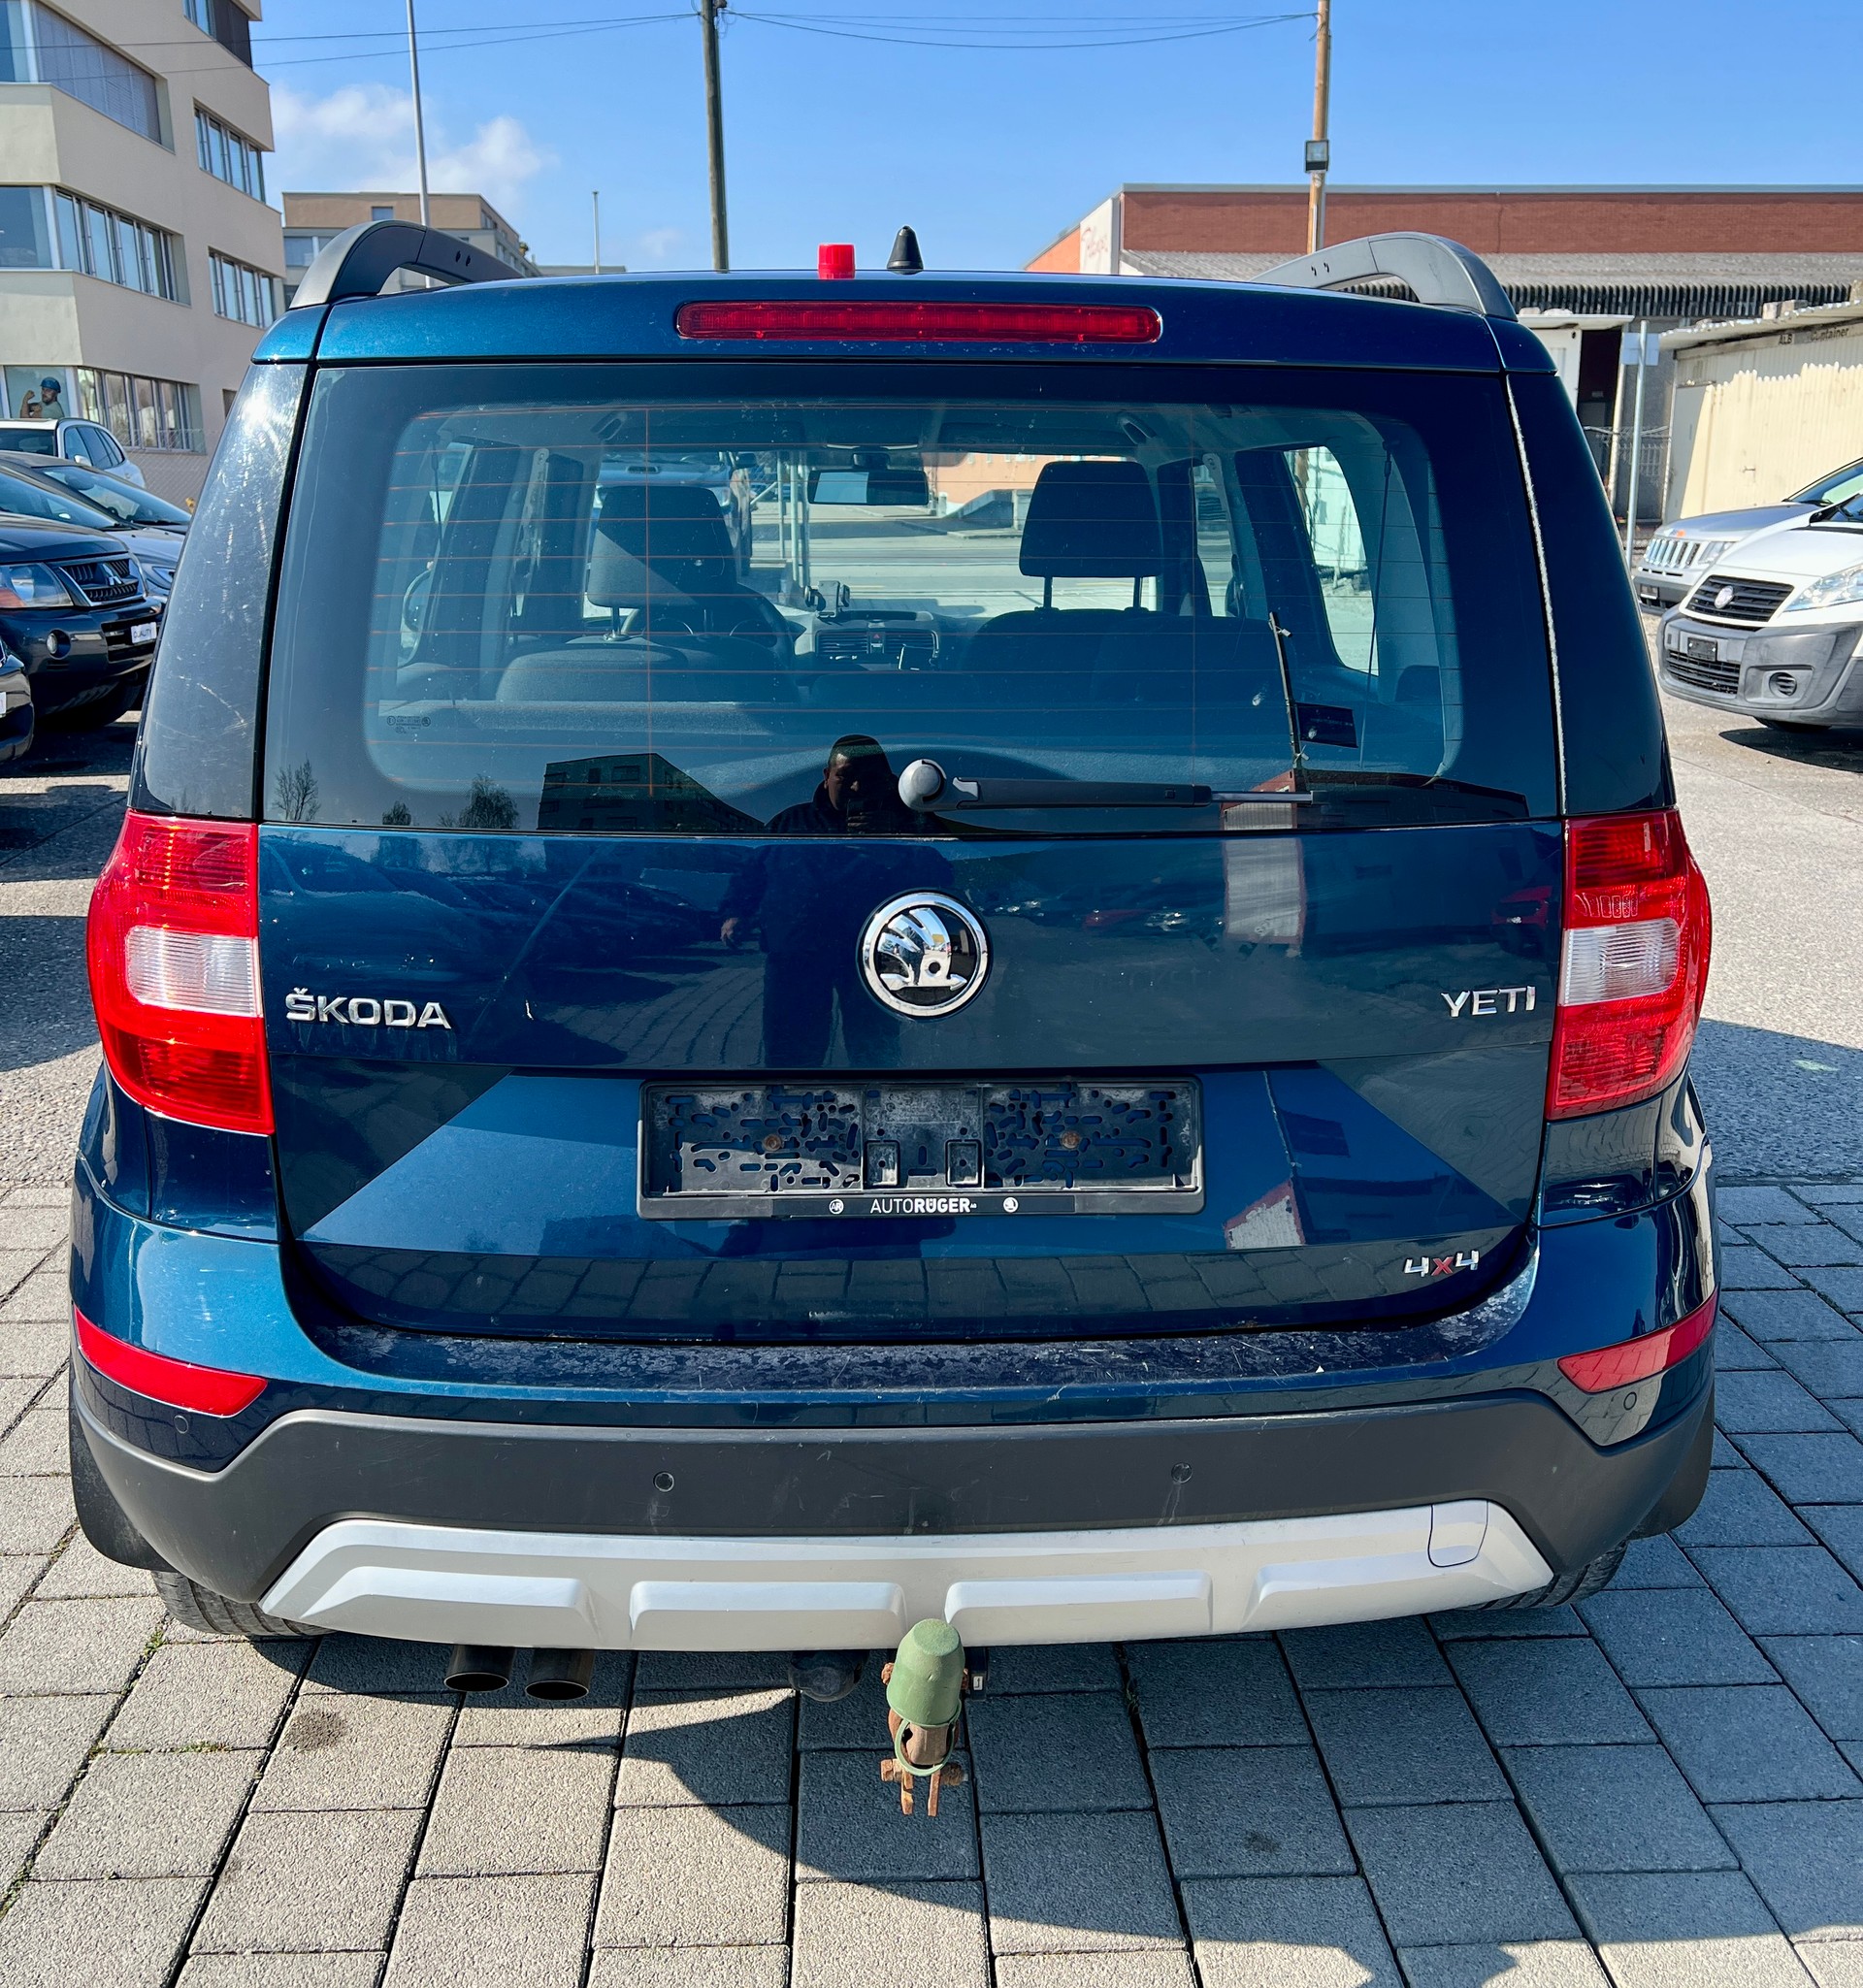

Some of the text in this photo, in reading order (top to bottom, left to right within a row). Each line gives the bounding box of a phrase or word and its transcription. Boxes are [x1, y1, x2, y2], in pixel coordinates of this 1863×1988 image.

[285, 987, 452, 1029] ŠKODA
[1441, 985, 1536, 1018] YETI
[1404, 1250, 1480, 1278] 4x4
